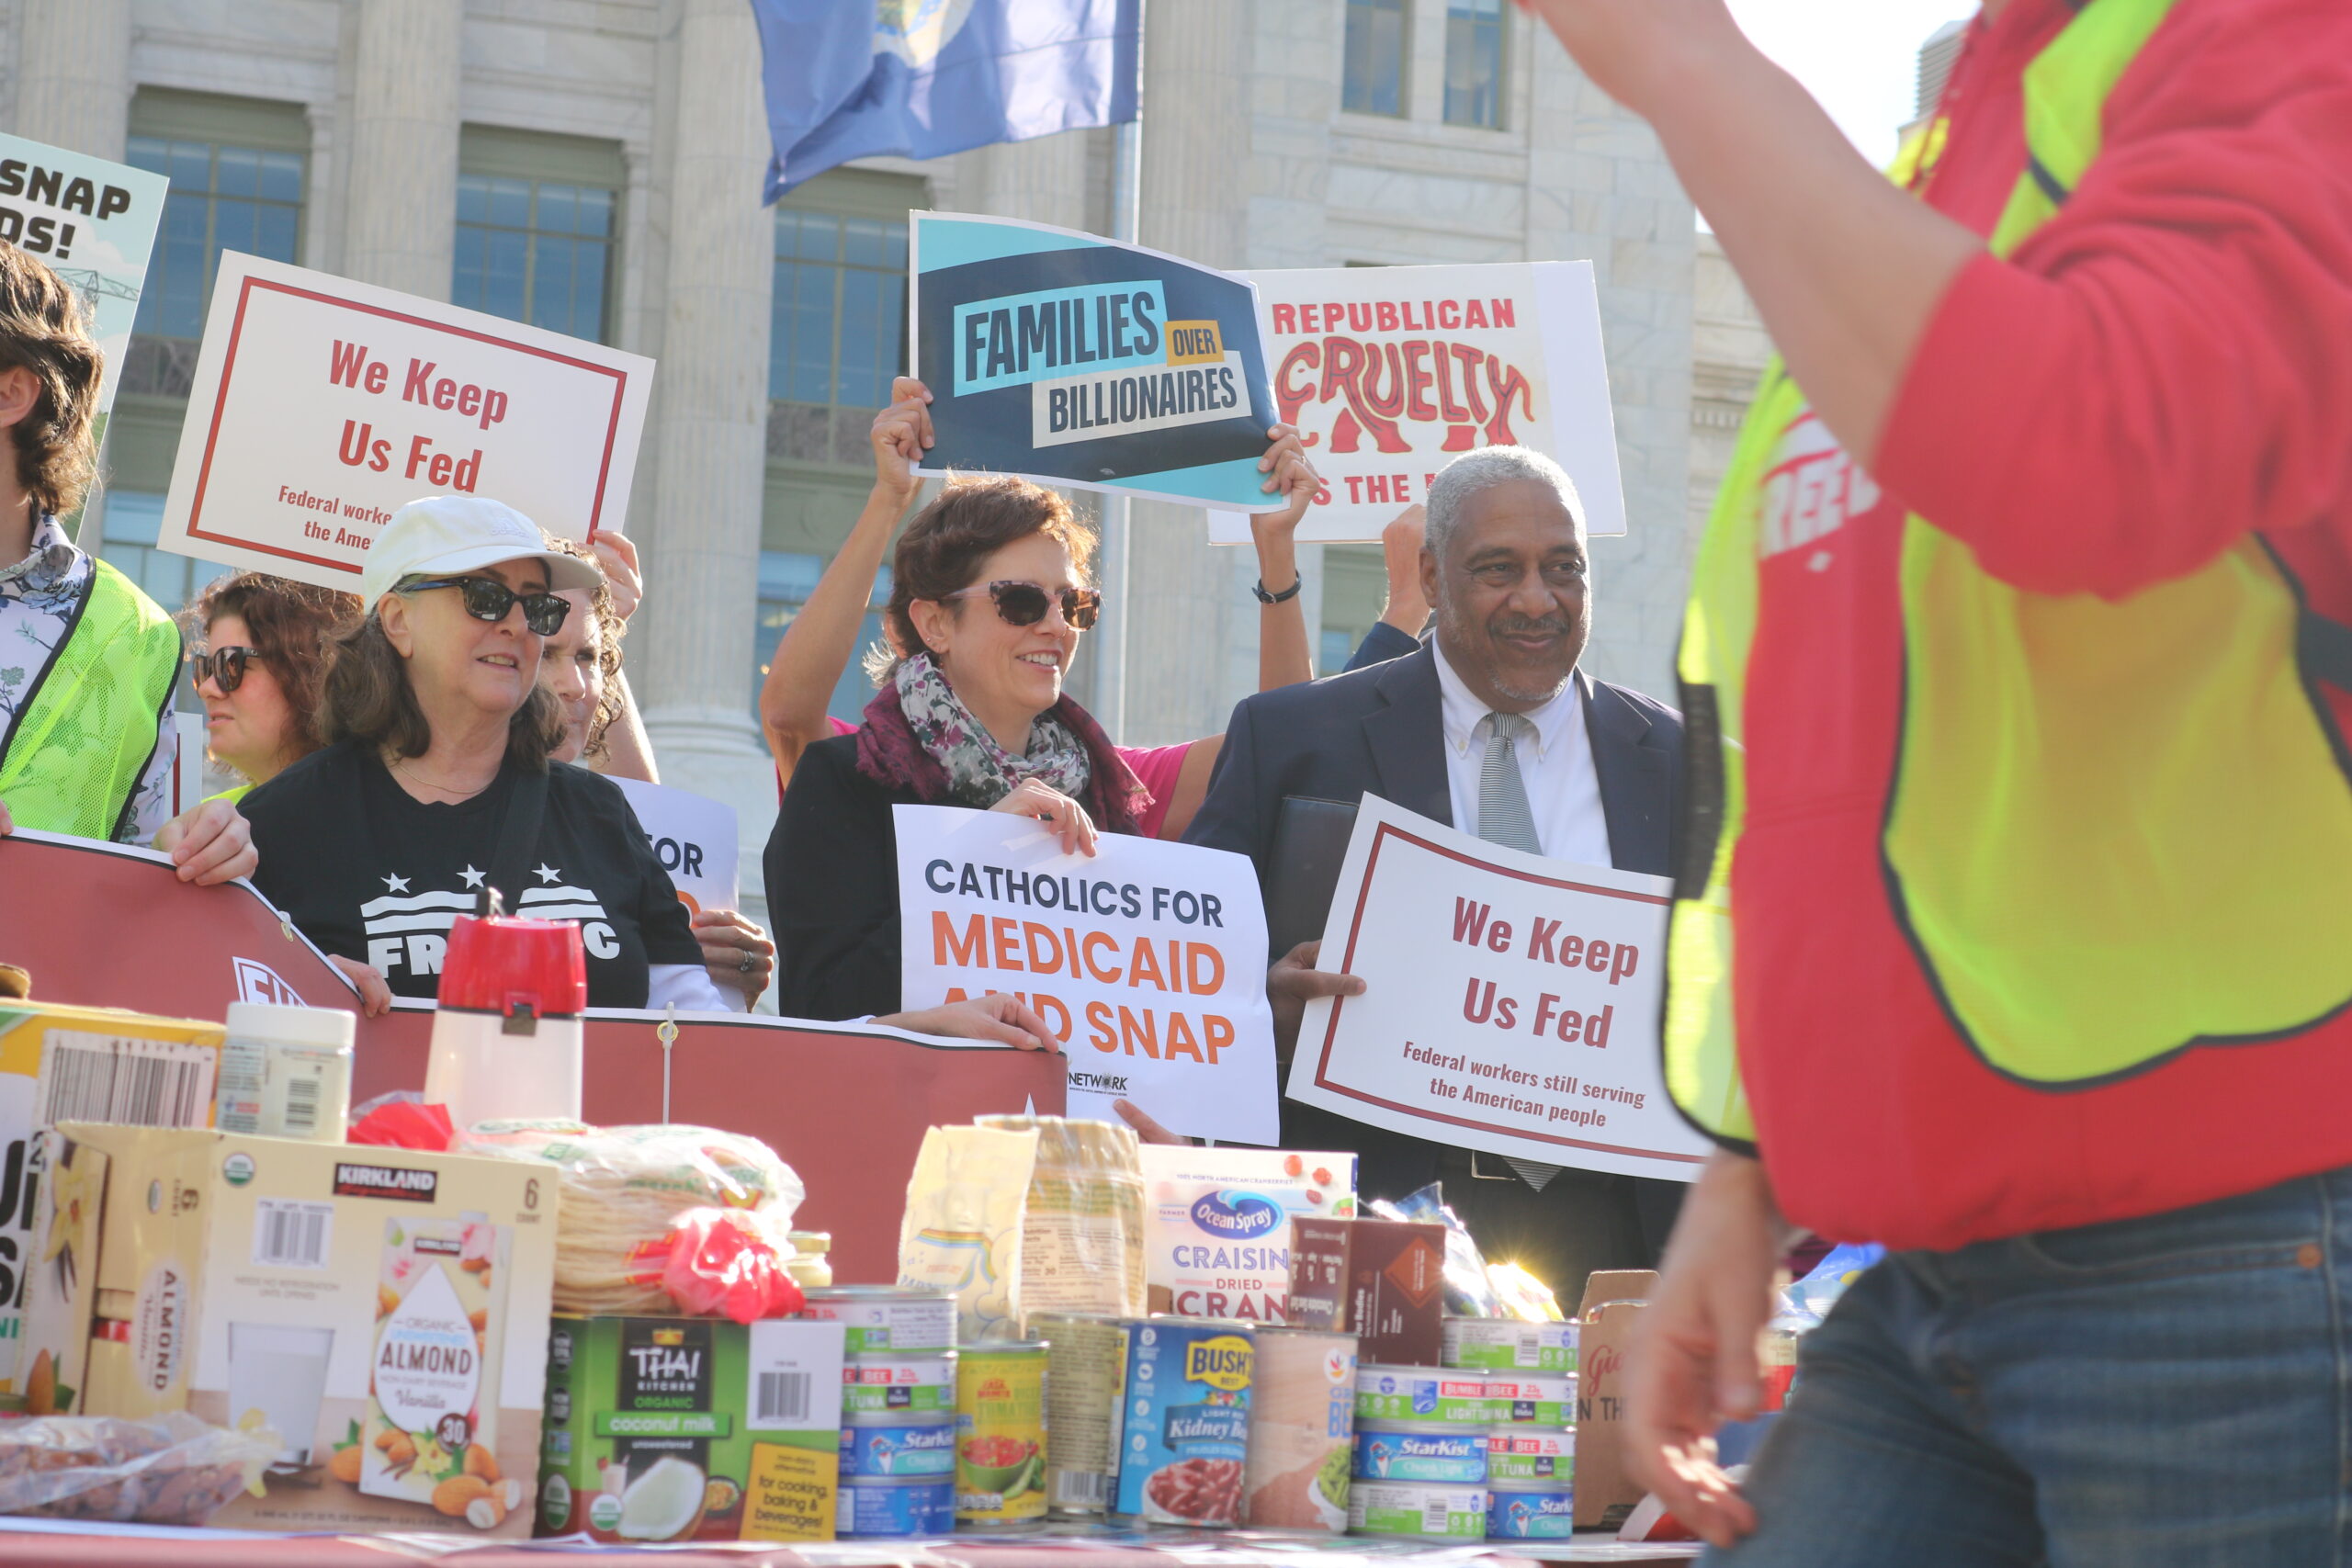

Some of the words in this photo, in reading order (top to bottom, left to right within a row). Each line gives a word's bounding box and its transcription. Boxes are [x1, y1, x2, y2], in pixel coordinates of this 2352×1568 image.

[0, 159, 130, 220] SNAP
[0, 207, 75, 260] DS!
[1272, 299, 1516, 334] REPUBLICAN
[965, 291, 1159, 382] FAMILIES
[1172, 328, 1216, 357] OVER
[330, 339, 389, 394] We
[402, 357, 508, 431] Keep
[1049, 367, 1238, 434] BILLIONAIRES
[1276, 336, 1535, 453] CRUELTY
[339, 419, 391, 472] Us
[405, 434, 482, 493] Fed
[278, 485, 340, 514] Federal
[344, 503, 392, 525] worke
[1345, 474, 1410, 504] THE
[304, 521, 331, 541] the
[645, 833, 703, 878] OR
[925, 859, 1141, 919] CATHOLICS
[1153, 887, 1224, 928] FOR
[368, 933, 447, 979] FR
[932, 911, 1226, 996] MEDICAID
[1453, 896, 1512, 953] We
[1527, 916, 1639, 986] Keep
[1463, 977, 1517, 1030] Us
[1532, 993, 1613, 1049] Fed
[1086, 1000, 1236, 1065] SNAP
[1403, 1041, 1465, 1072] Federal
[1470, 1060, 1538, 1088] workers
[1544, 1073, 1577, 1094] still
[1582, 1081, 1645, 1110] serving
[1430, 1077, 1457, 1100] the
[1463, 1086, 1544, 1117] American
[1548, 1104, 1606, 1127] people
[338, 1165, 435, 1190] KIRKLAND
[525, 1178, 539, 1210] 6
[1197, 1203, 1235, 1229] Ocean
[1236, 1207, 1272, 1234] Spray
[1172, 1246, 1289, 1270] CRAISIN
[1216, 1278, 1263, 1290] DRIED
[1177, 1290, 1290, 1323] CRAN
[154, 1269, 176, 1391] ALMOND
[380, 1342, 471, 1374] ALMOND
[628, 1347, 701, 1380] THAI
[634, 1395, 695, 1409] ORGANIC
[638, 1381, 695, 1391] KITCHEN
[441, 1417, 467, 1446] 30
[609, 1416, 679, 1432] coconut
[683, 1416, 716, 1432] milk
[1170, 1418, 1229, 1440] Kidney
[1401, 1439, 1470, 1456] StarKist
[1502, 1464, 1533, 1476] TUNA
[763, 1493, 806, 1513] baking
